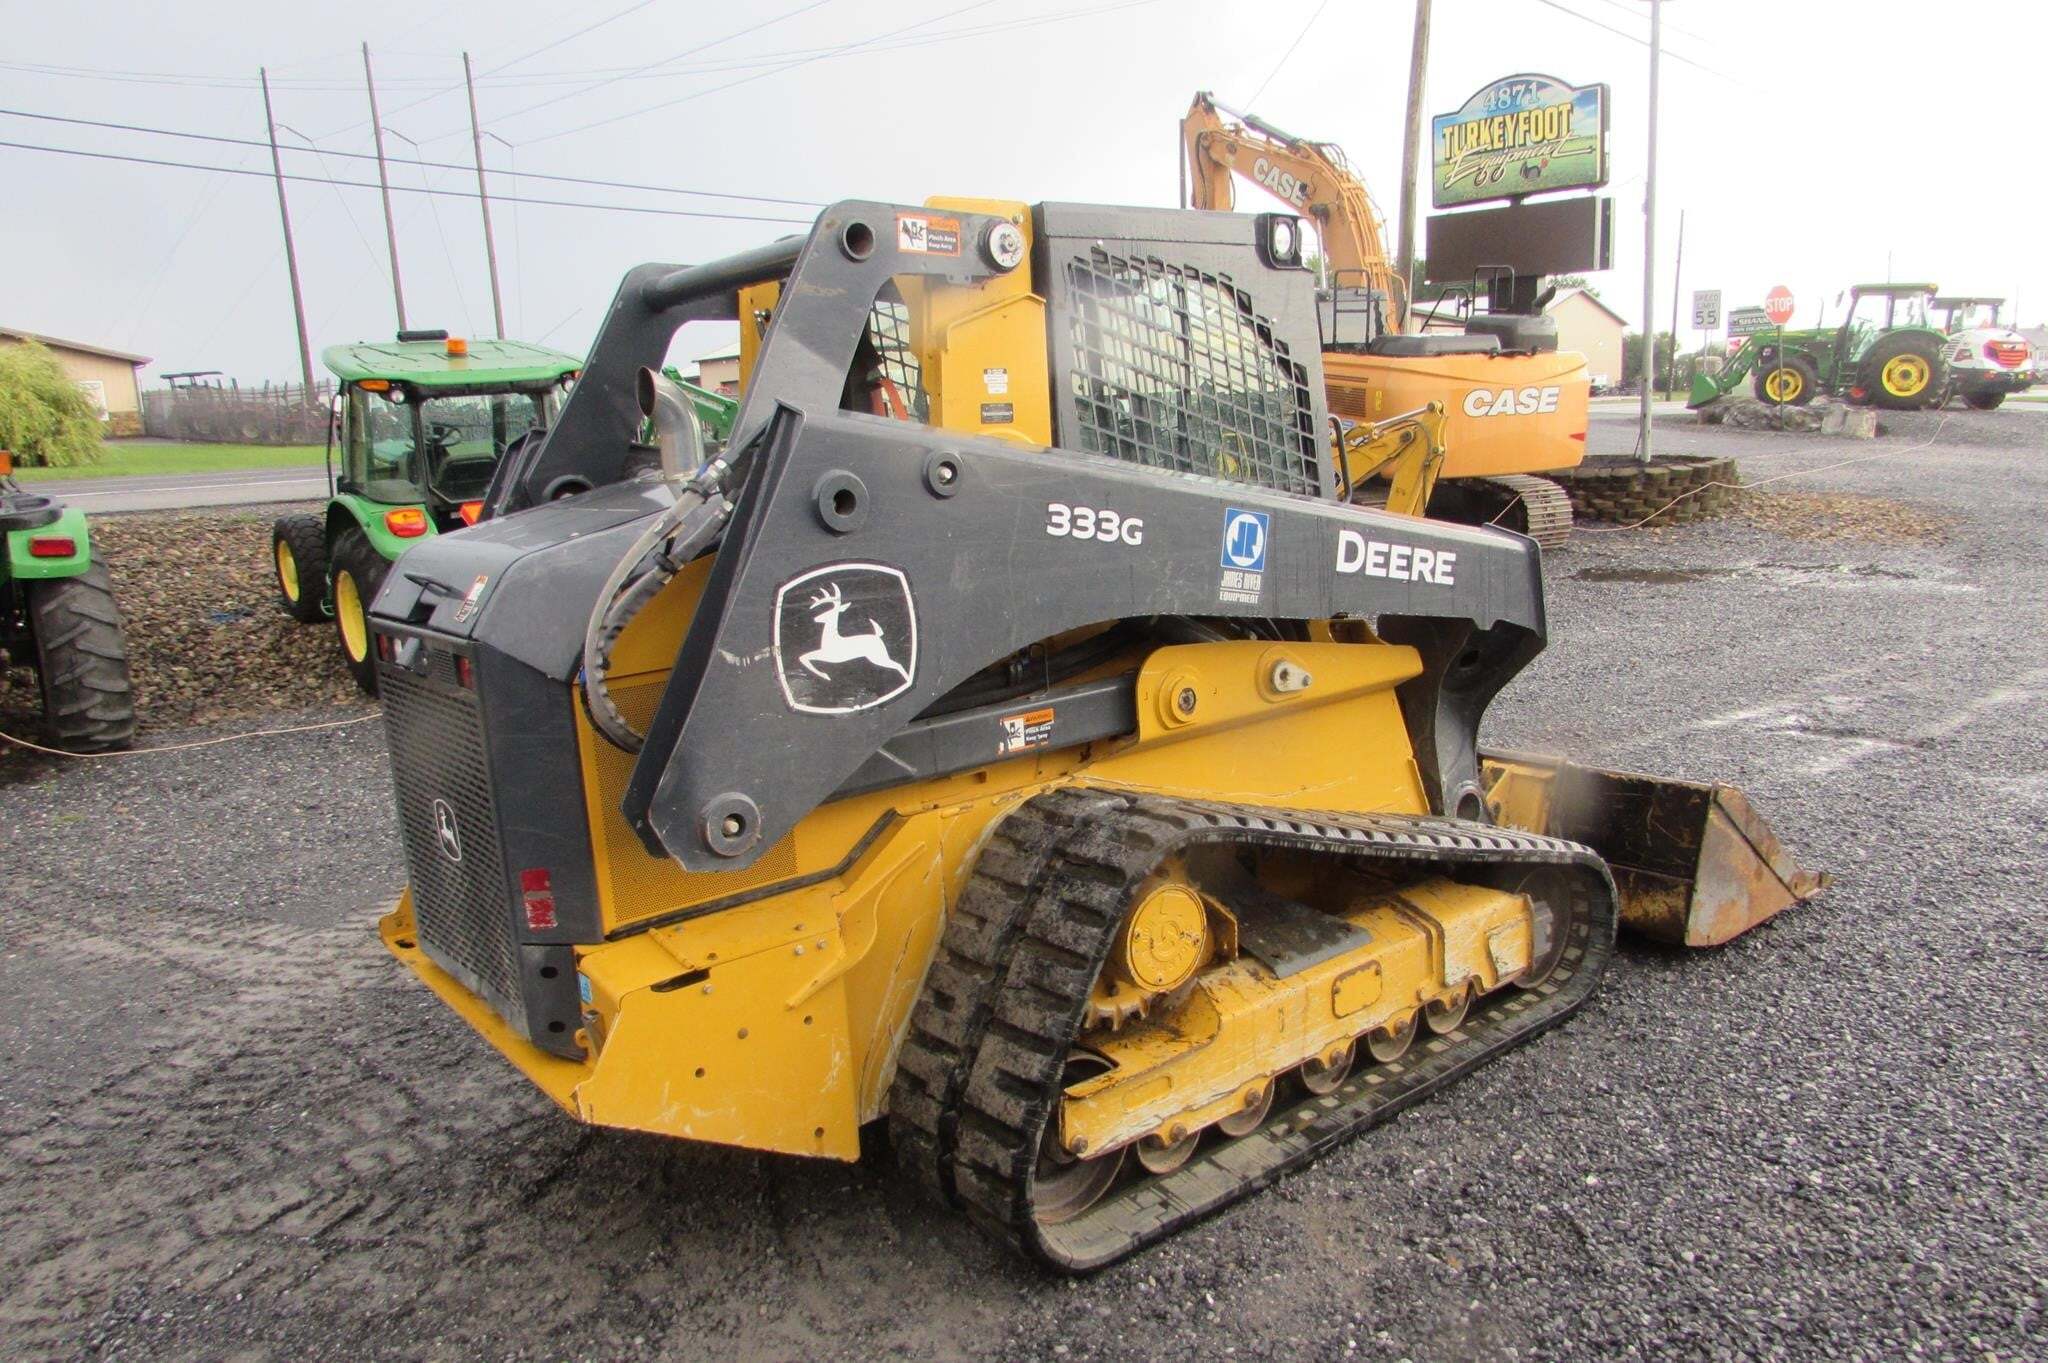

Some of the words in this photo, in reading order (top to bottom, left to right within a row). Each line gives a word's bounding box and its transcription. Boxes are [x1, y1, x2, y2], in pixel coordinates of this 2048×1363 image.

[1483, 81, 1542, 112] 4871
[1442, 103, 1573, 160] TURKEYFOOT
[1444, 131, 1594, 189] Equipment
[1253, 157, 1309, 207] CASE
[1695, 311, 1717, 325] 55
[1766, 297, 1793, 313] STOP
[1462, 386, 1561, 417] CASE
[1046, 503, 1144, 546] 333G
[1335, 529, 1458, 586] DEERE
